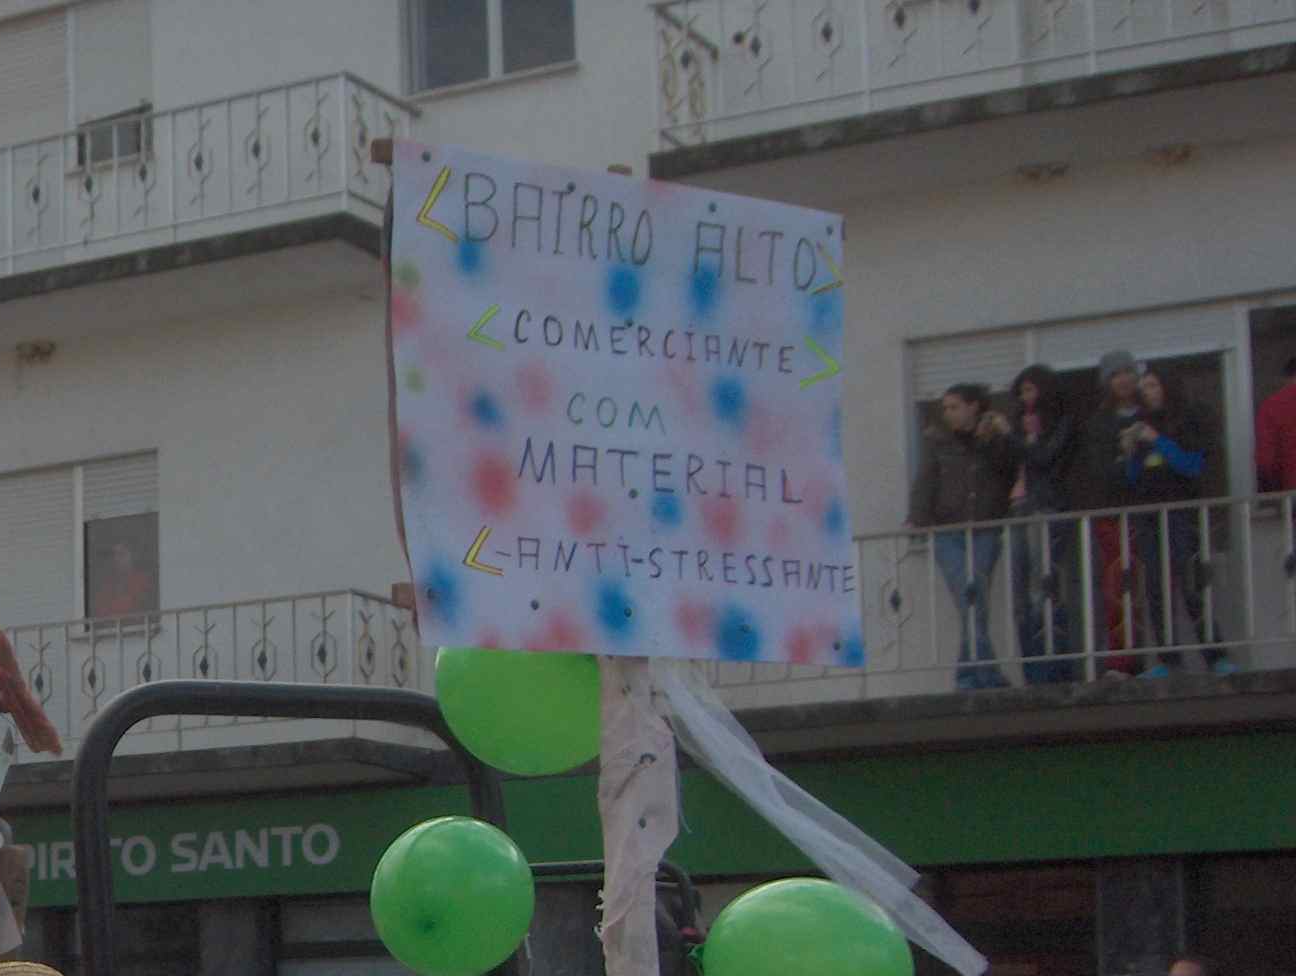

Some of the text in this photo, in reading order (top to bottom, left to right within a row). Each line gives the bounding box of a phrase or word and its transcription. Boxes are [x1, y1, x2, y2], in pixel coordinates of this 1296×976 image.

[463, 171, 817, 292] BAIRRO ALTO
[513, 307, 796, 375] COMERCIANTE
[567, 389, 667, 436] COM
[517, 437, 804, 506] MATERIAL
[170, 822, 341, 873] SANTO
